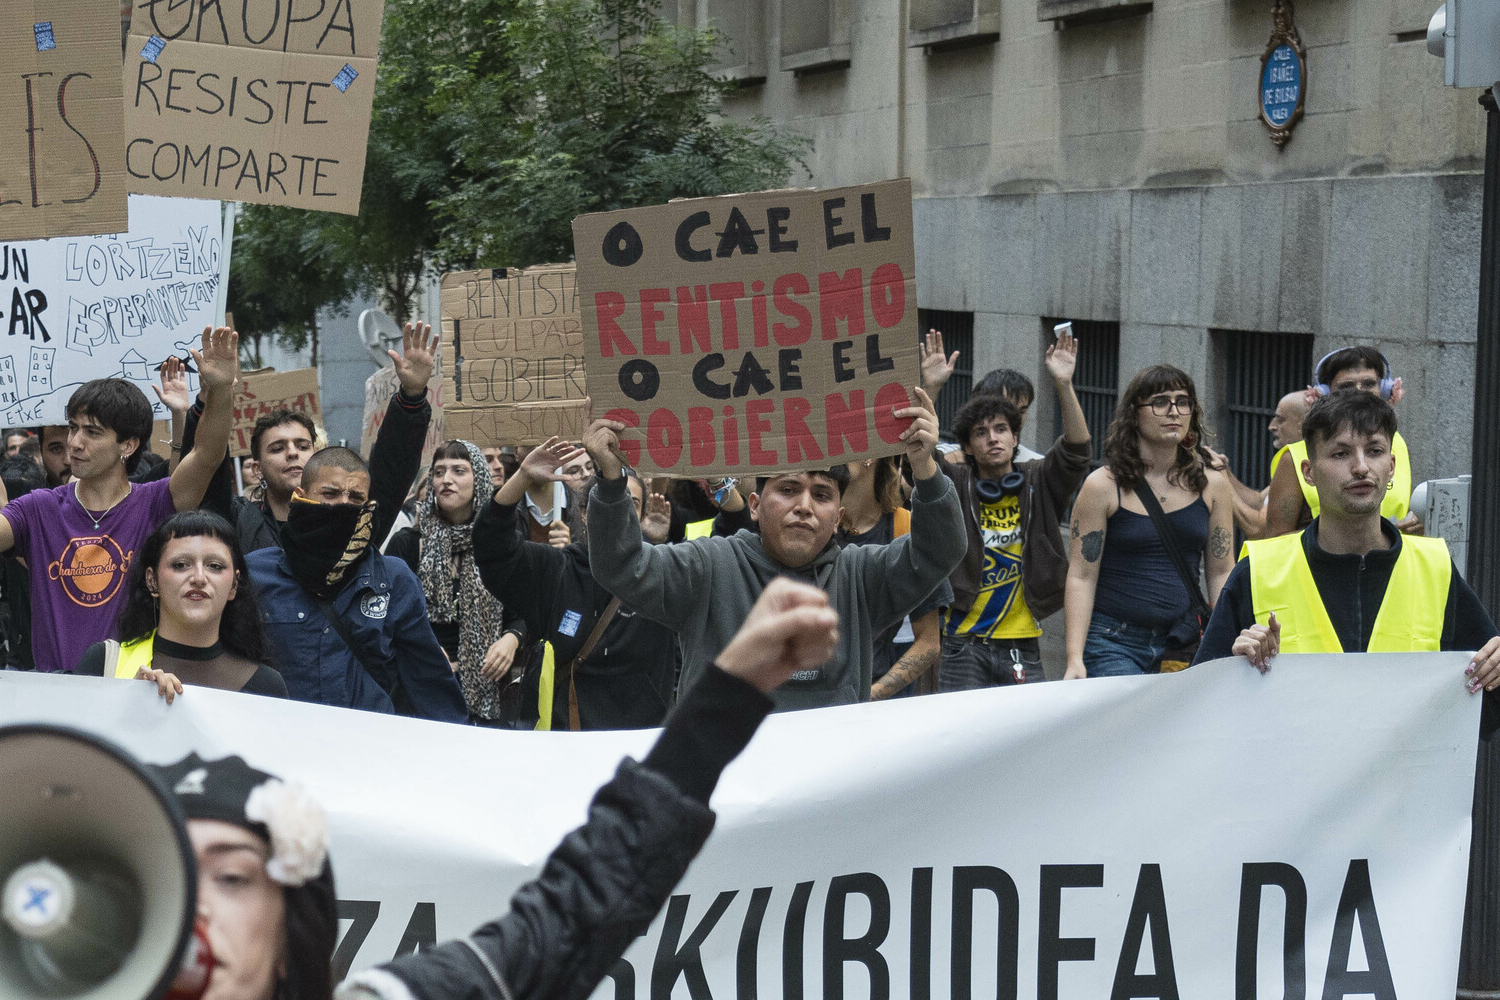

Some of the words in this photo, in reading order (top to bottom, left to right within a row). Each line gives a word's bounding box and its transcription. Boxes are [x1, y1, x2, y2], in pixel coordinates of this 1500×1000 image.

[135, 61, 331, 125] RESISTE
[125, 137, 339, 197] COMPARTE
[65, 225, 221, 287] LORTZEKO
[602, 220, 644, 267] O
[674, 205, 798, 262] CAE
[823, 193, 892, 250] EL
[473, 319, 583, 353] CULPAB
[468, 354, 587, 402] GOBIER
[618, 358, 660, 402] O
[692, 348, 804, 399] CAE
[832, 333, 895, 383] EL
[81, 593, 103, 602] 2024
